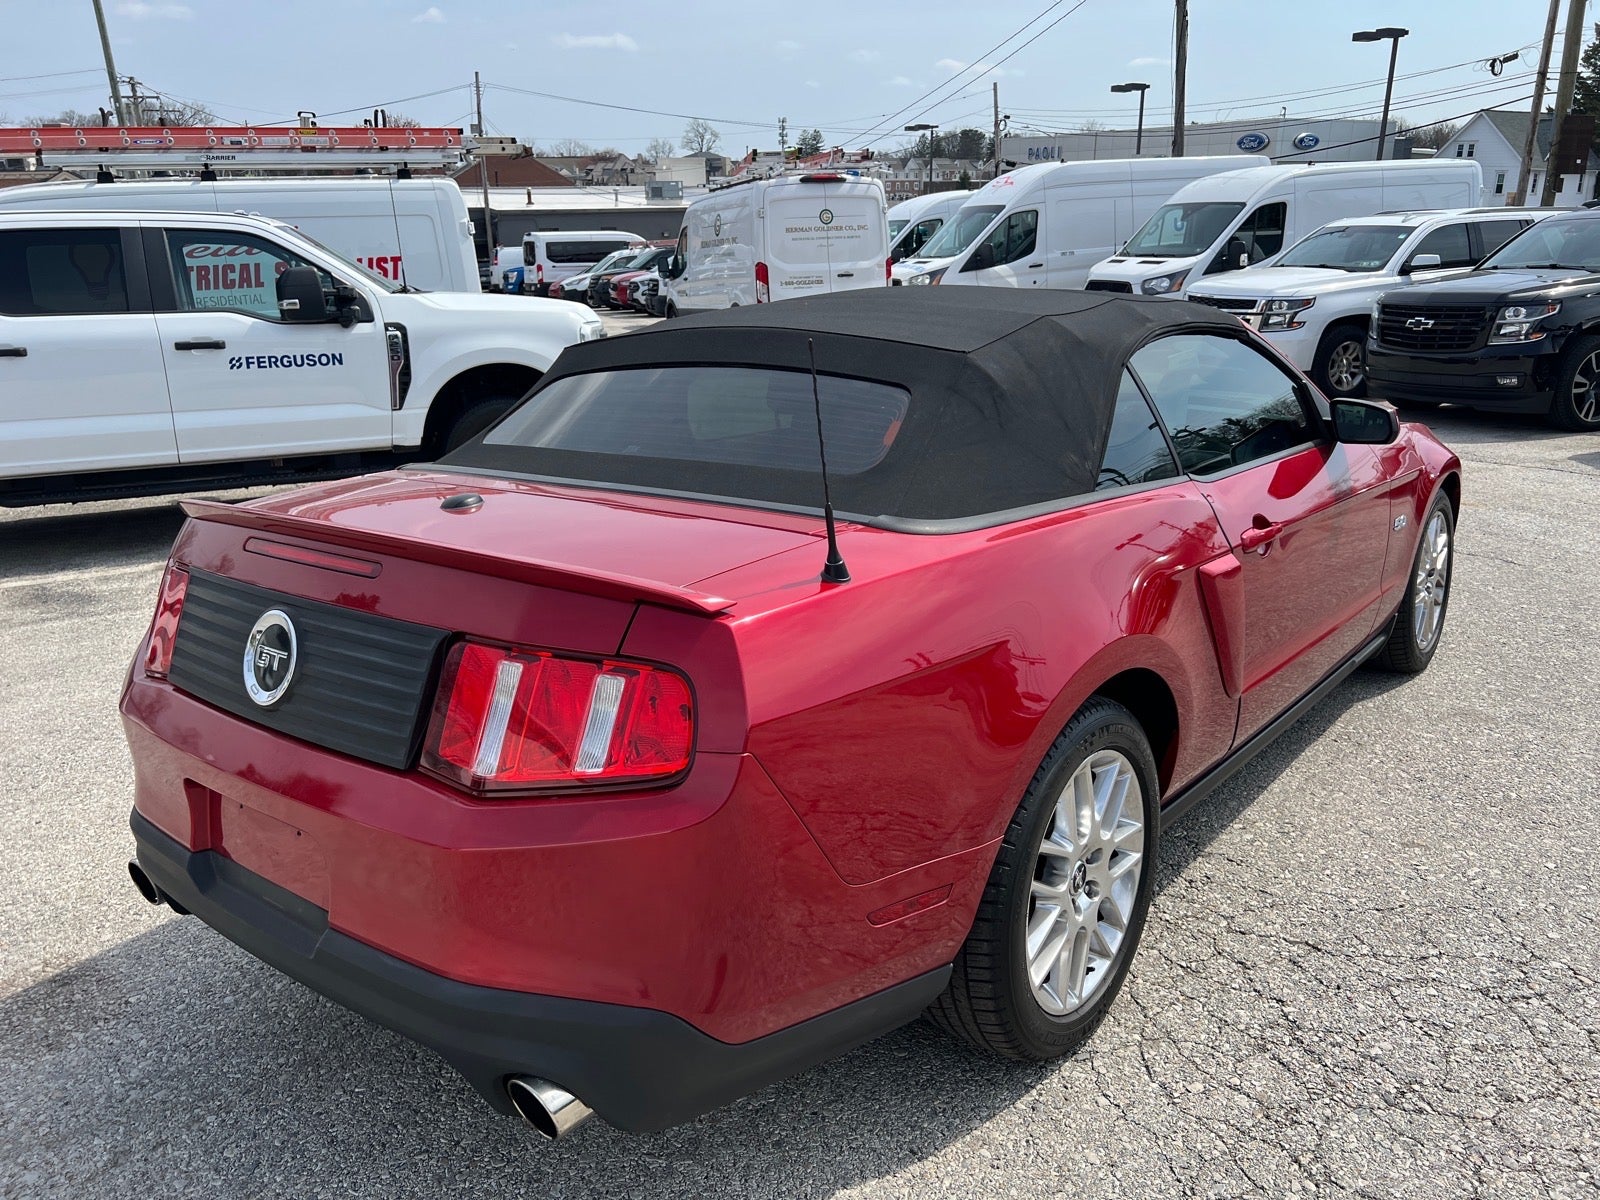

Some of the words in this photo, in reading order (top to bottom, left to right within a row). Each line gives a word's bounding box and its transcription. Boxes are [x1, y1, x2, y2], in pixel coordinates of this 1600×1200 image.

[1028, 146, 1062, 160] PAOLI
[785, 225, 812, 233] HERMAN
[357, 256, 402, 281] IST
[196, 293, 266, 308] RESIDENTIAL
[245, 352, 343, 370] FERGUSON
[255, 644, 288, 671] GT
